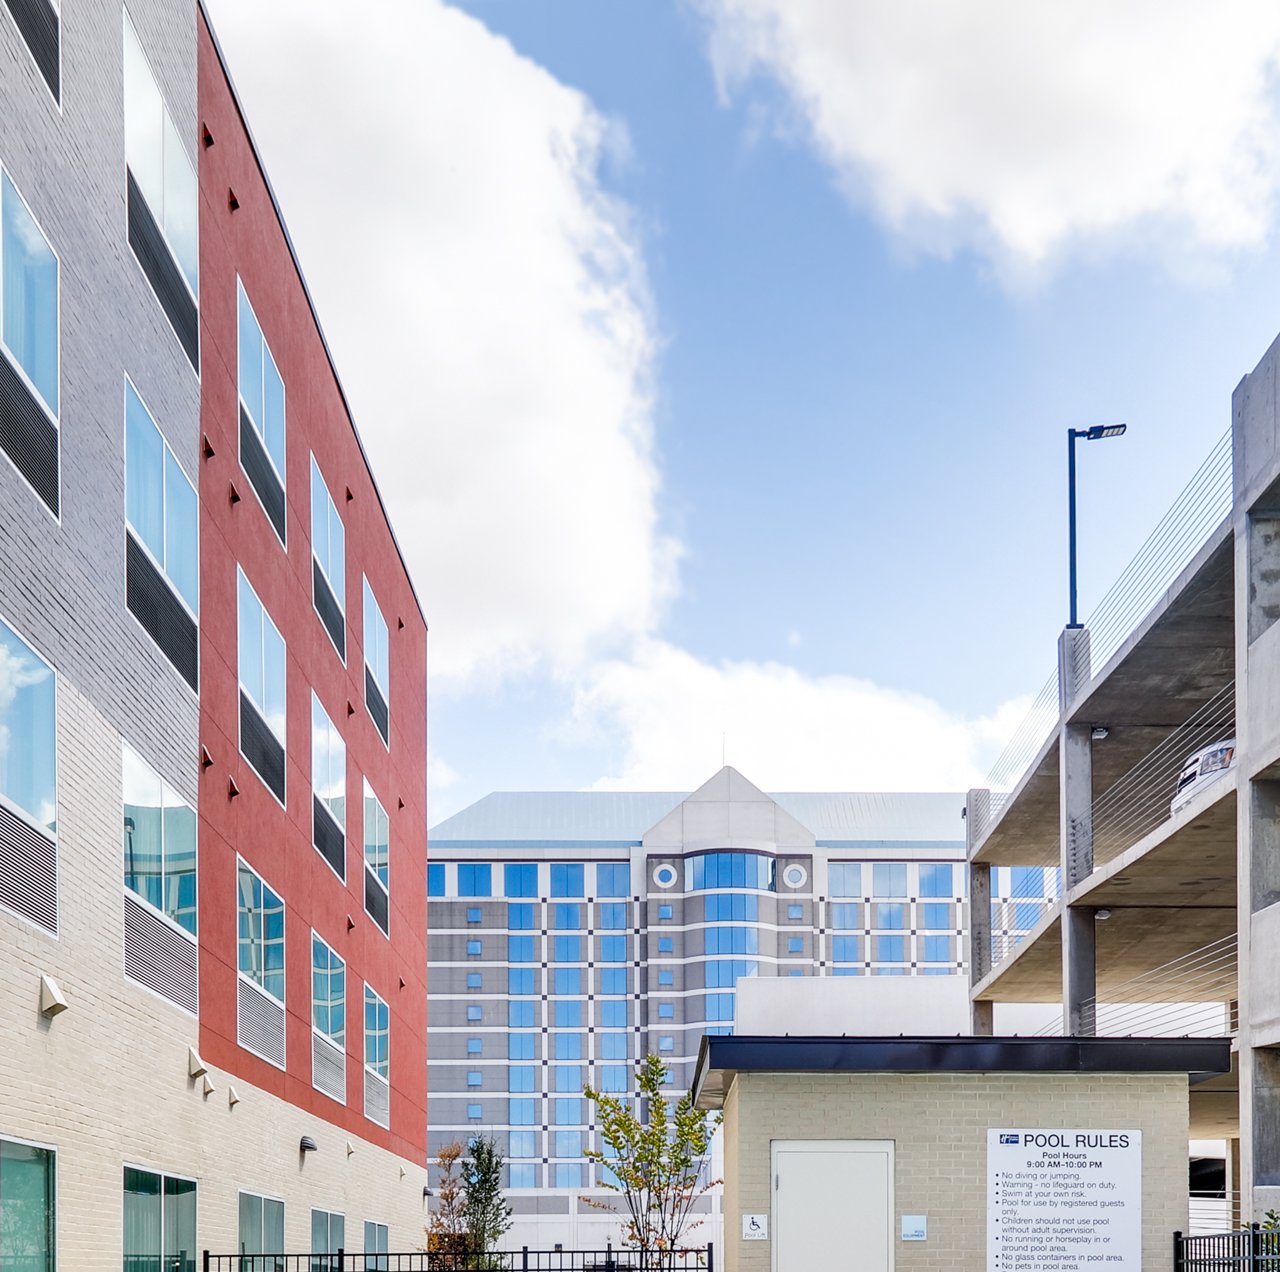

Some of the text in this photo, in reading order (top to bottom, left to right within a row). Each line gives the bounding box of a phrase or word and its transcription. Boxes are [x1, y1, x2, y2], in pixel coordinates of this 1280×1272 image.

[1024, 1134, 1070, 1148] POOL
[1076, 1135, 1130, 1148] RULES
[1015, 1172, 1037, 1180] diving
[1001, 1181, 1032, 1189] Warning
[1049, 1200, 1058, 1208] by
[1061, 1200, 1097, 1208] registered
[1001, 1208, 1019, 1216] only.
[1093, 1218, 1109, 1226] pool
[1001, 1226, 1096, 1235] without adult supervision.
[1001, 1235, 1013, 1243] No
[1015, 1236, 1043, 1244] running
[1055, 1236, 1091, 1244] horseplay
[1030, 1245, 1047, 1253] pool
[1015, 1254, 1035, 1262] glass
[1087, 1254, 1104, 1262] pool
[1043, 1263, 1059, 1271] pool
